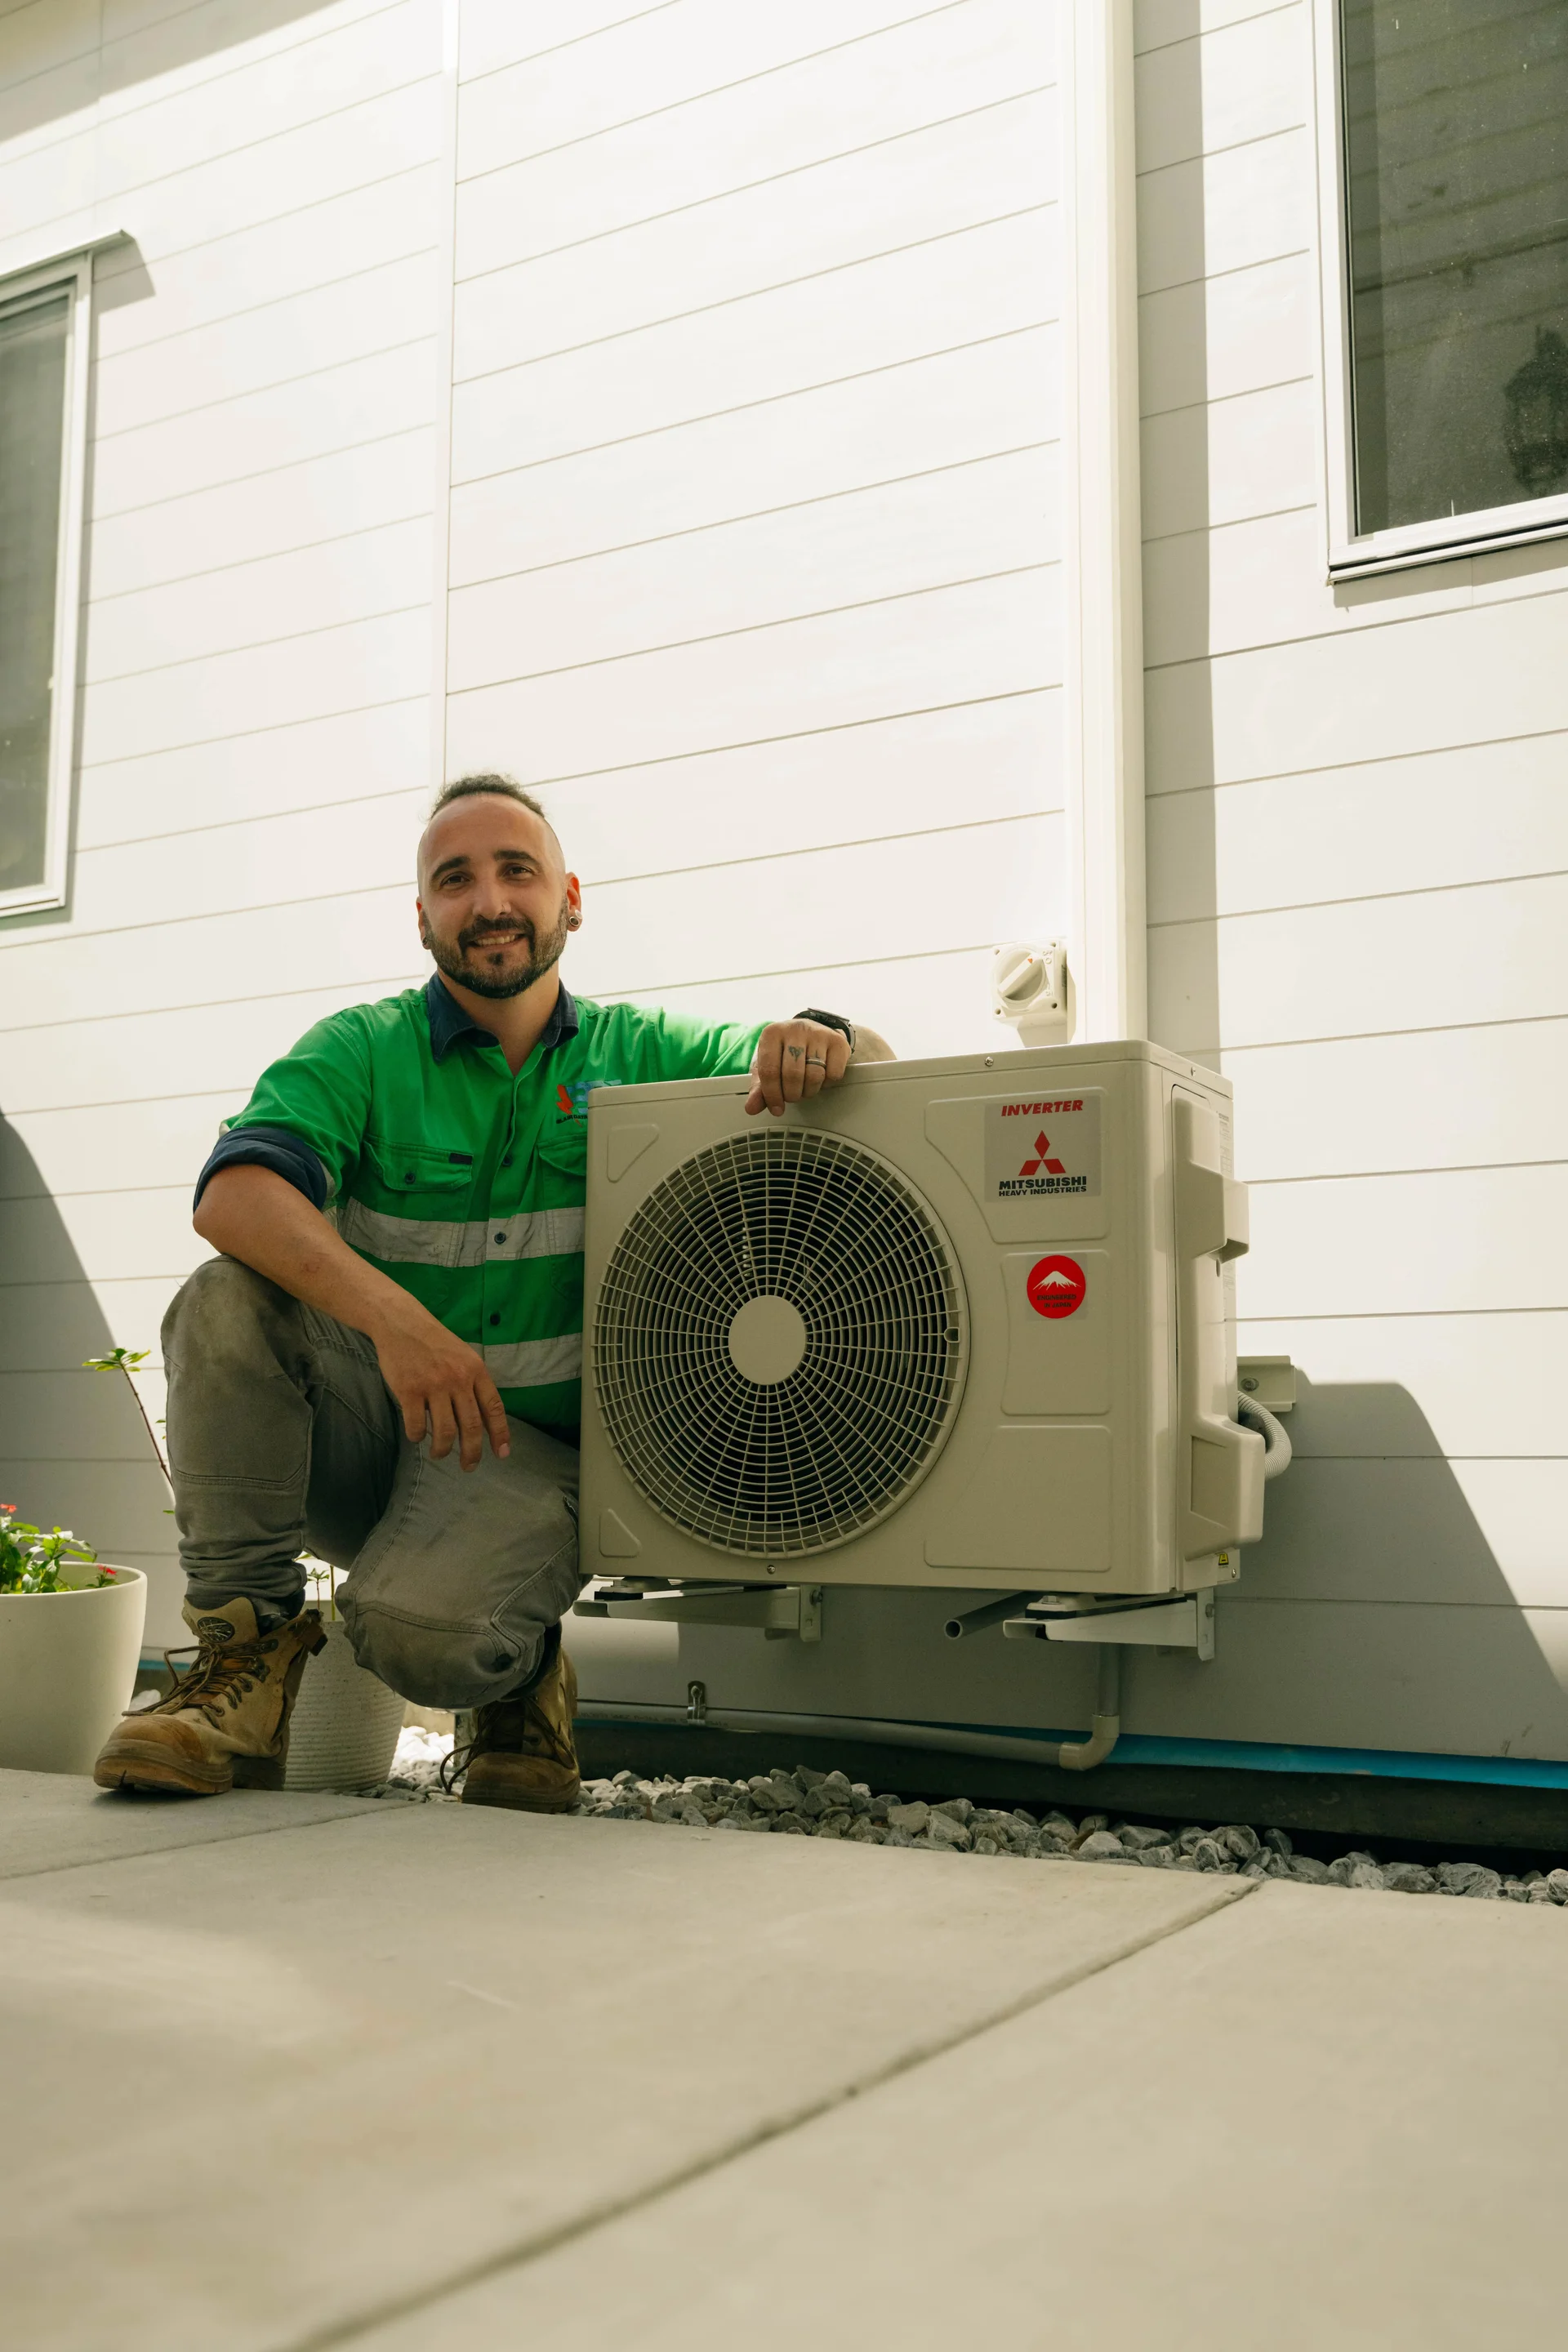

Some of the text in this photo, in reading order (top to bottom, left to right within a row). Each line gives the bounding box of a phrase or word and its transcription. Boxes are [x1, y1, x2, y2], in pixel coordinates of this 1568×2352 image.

[1001, 1100, 1083, 1116] INVERTER
[999, 1176, 1087, 1190] MITSUBISHI
[1030, 1186, 1087, 1195] INDUSTRIES
